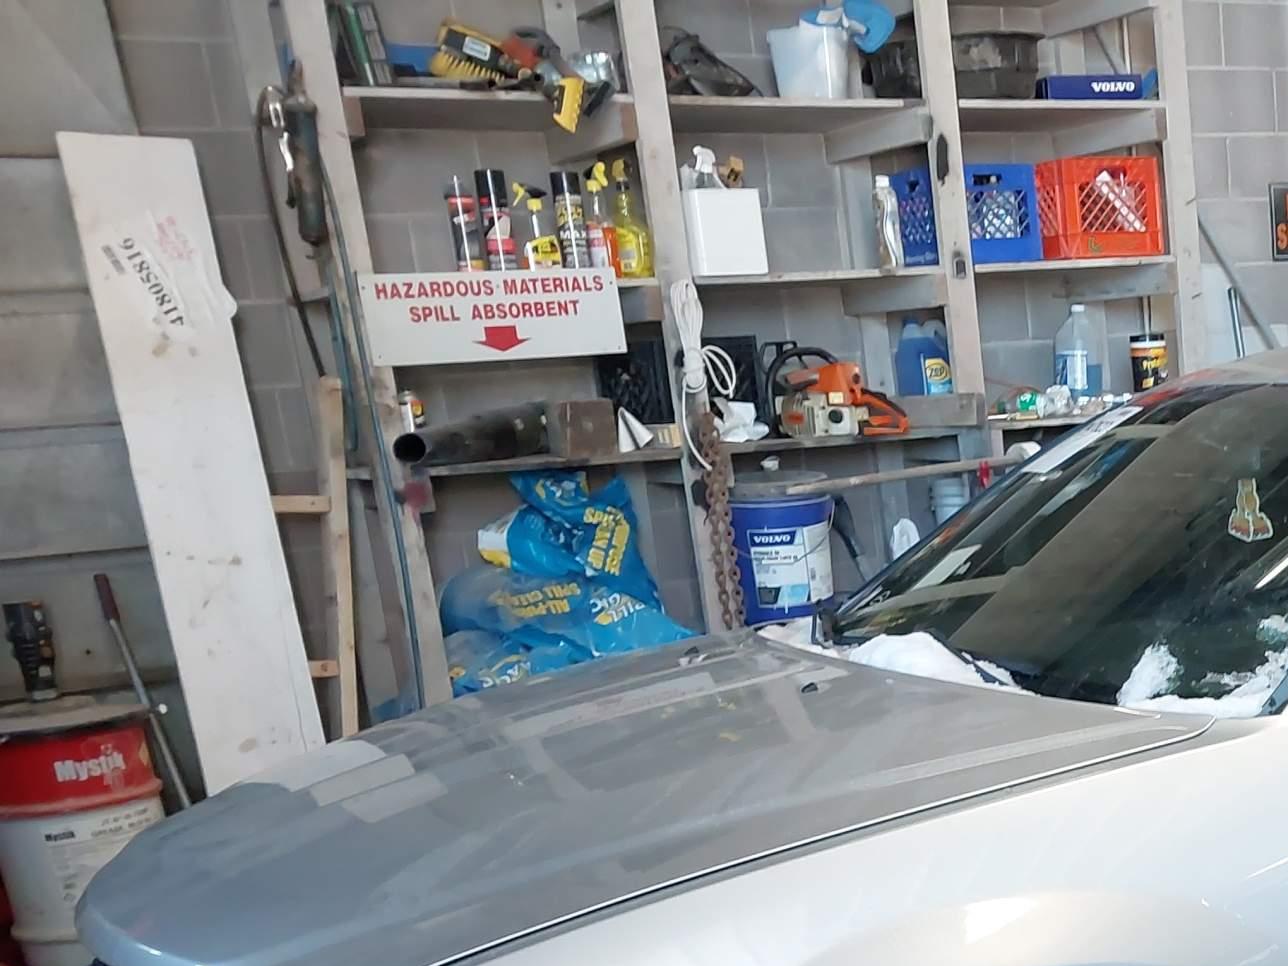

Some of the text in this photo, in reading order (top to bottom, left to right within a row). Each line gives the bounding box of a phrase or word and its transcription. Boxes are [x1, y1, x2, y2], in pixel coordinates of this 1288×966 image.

[1091, 81, 1136, 93] VOLVO
[119, 237, 185, 326] 41805816
[374, 275, 604, 300] HAZARDOUS MATERIALS
[409, 300, 580, 323] SPILL ABSORBENT
[753, 534, 791, 544] VOLVO
[53, 751, 126, 783] Mystik
